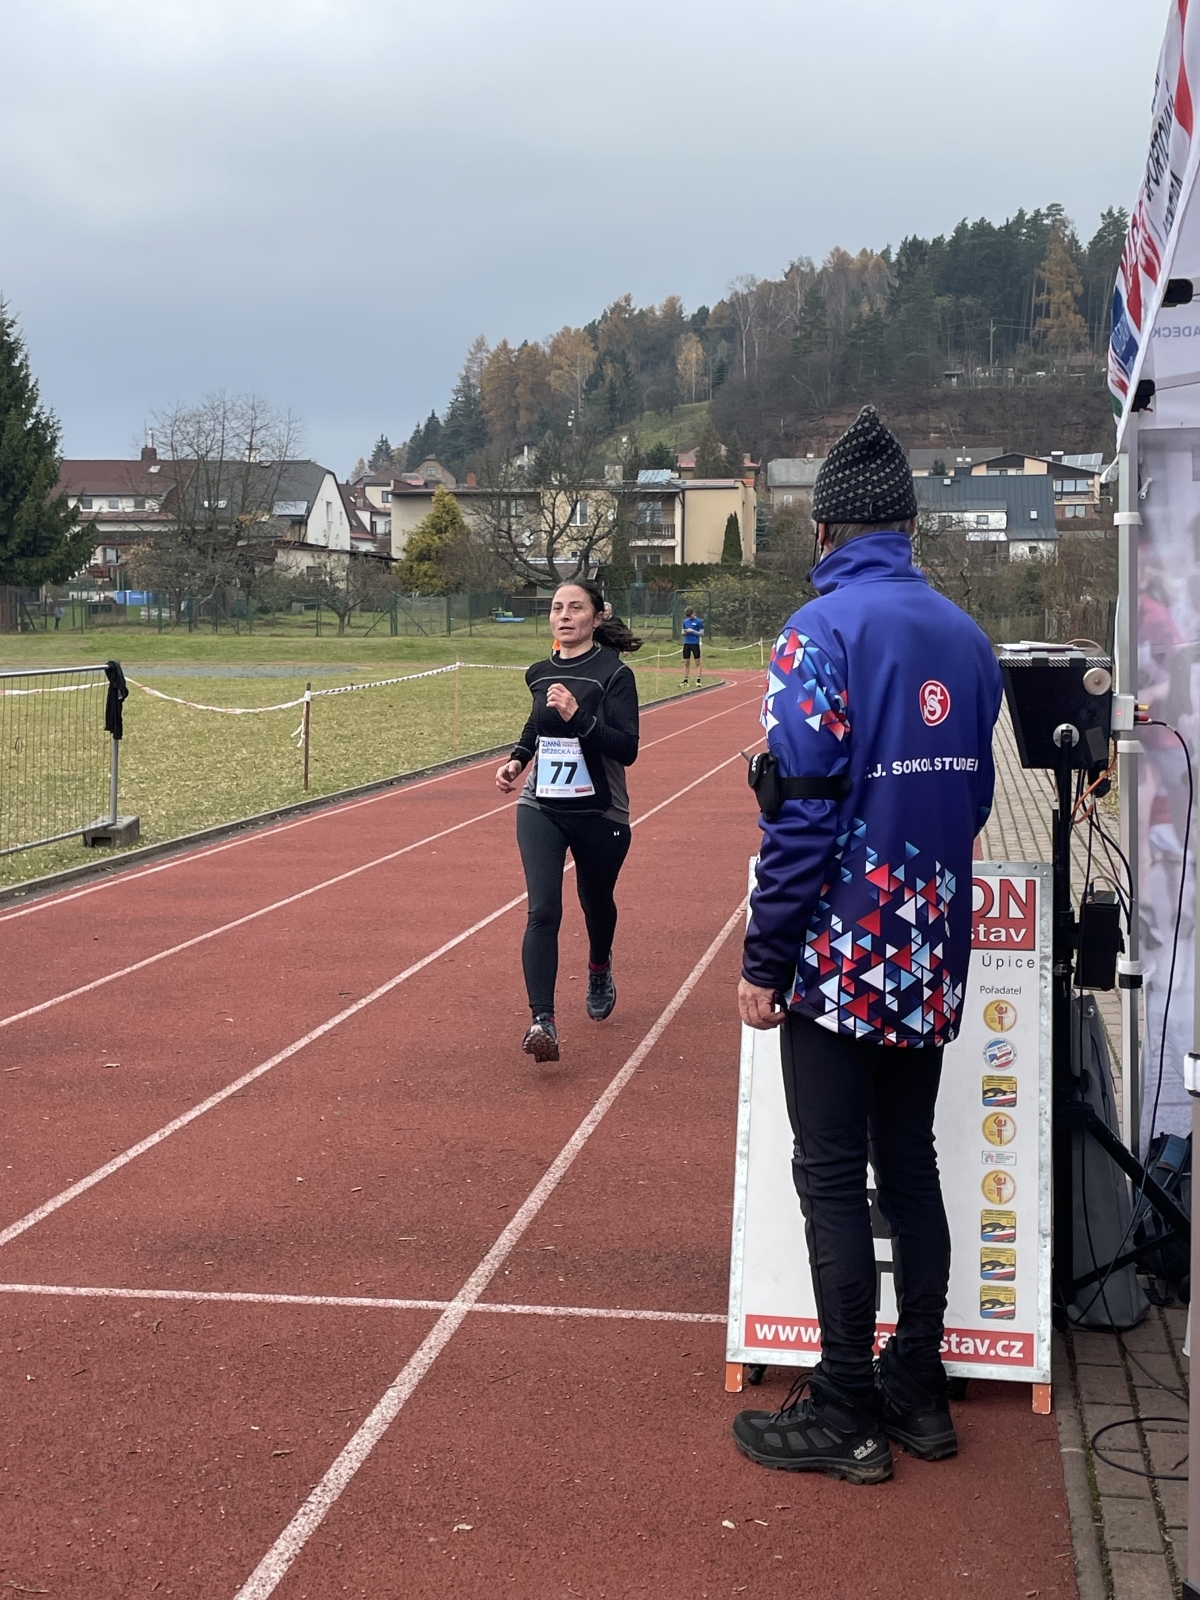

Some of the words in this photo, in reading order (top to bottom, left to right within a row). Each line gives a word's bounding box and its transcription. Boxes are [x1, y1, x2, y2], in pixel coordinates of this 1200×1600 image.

[550, 761, 578, 785] 77
[982, 953, 1035, 970] Úpice
[979, 985, 1022, 996] Pořadatel
